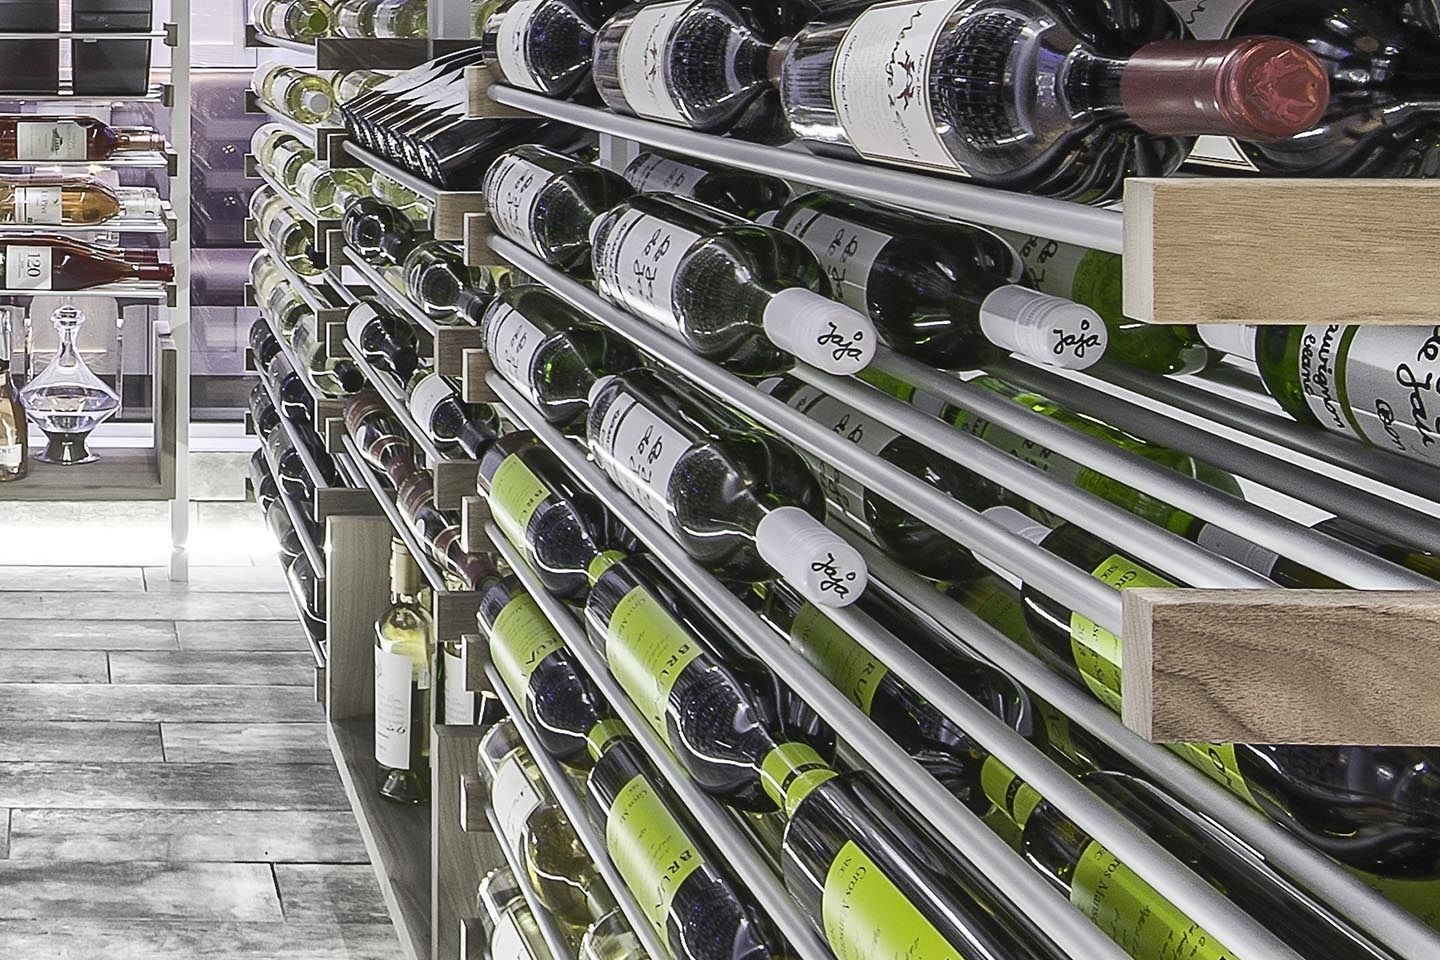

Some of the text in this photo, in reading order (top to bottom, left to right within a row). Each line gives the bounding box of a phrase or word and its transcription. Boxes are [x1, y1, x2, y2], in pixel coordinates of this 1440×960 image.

[26, 252, 41, 278] 120
[818, 322, 863, 361] Jaja
[1053, 319, 1101, 358] Jaja
[811, 552, 856, 600] Jaja
[1104, 858, 1121, 878] ros
